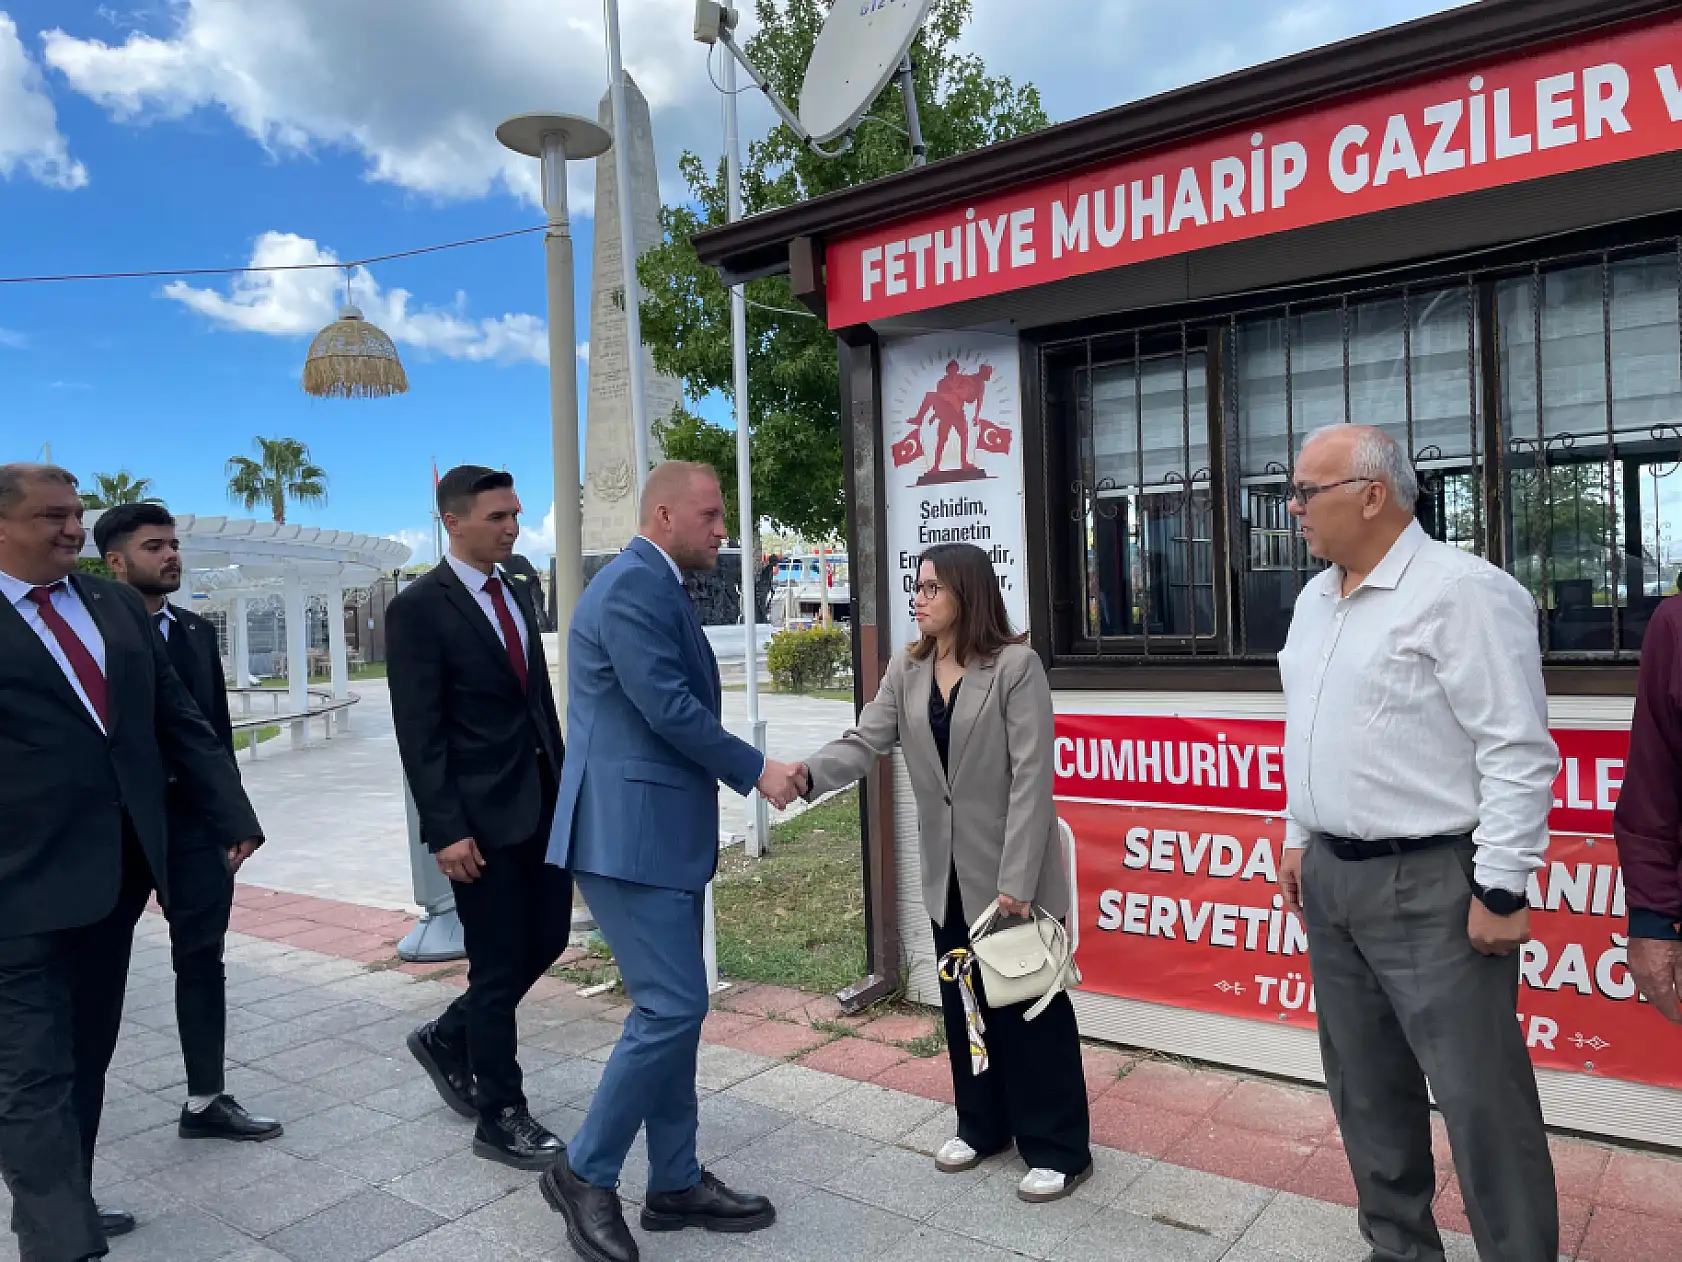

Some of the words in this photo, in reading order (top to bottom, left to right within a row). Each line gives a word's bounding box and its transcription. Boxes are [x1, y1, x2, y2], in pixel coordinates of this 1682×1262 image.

[861, 206, 1037, 302] FETHİYE
[1051, 131, 1307, 260] MUHARİP
[1328, 65, 1631, 193] GAZİLER
[918, 521, 991, 543] Emanetin
